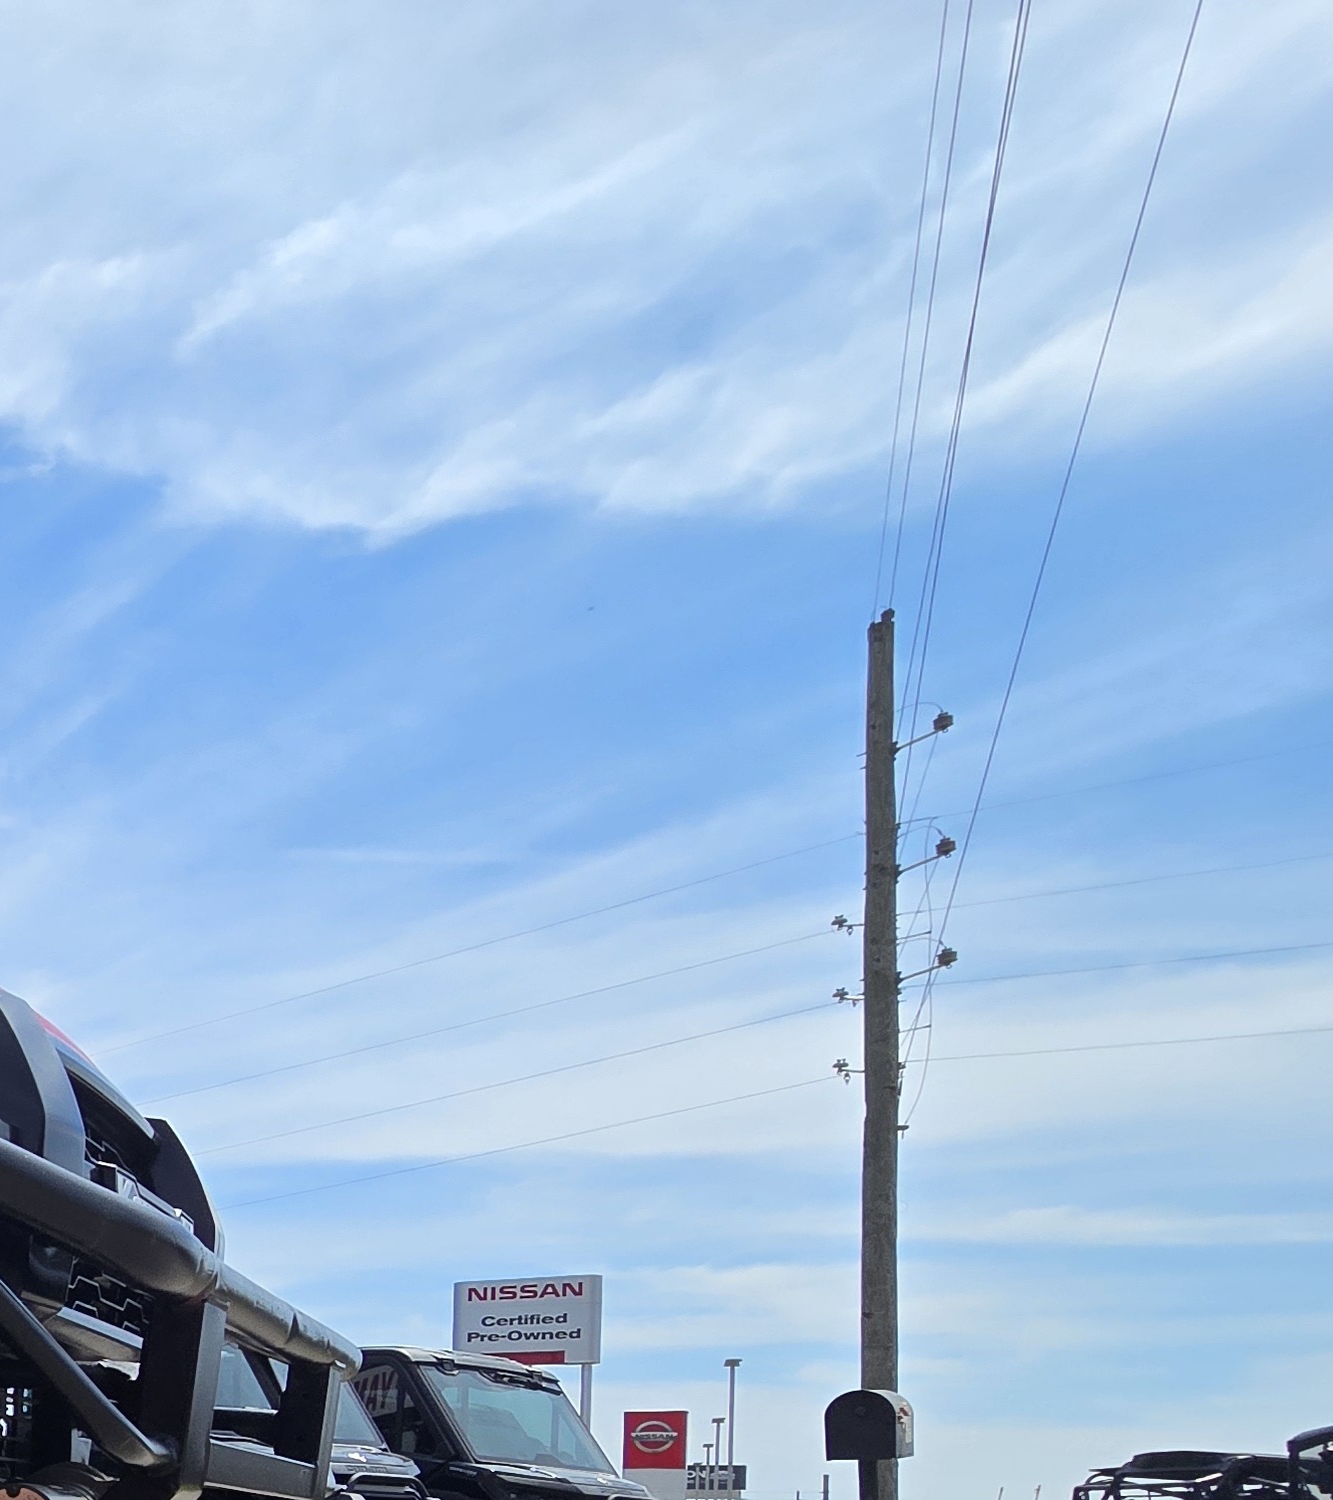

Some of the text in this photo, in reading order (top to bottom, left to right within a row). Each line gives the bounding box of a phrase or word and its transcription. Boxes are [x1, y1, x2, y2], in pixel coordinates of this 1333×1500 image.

[467, 1282, 583, 1302] NISSAN
[481, 1313, 568, 1327] Certified
[467, 1328, 582, 1343] Pre-Owned
[634, 1433, 675, 1441] NISSAN
